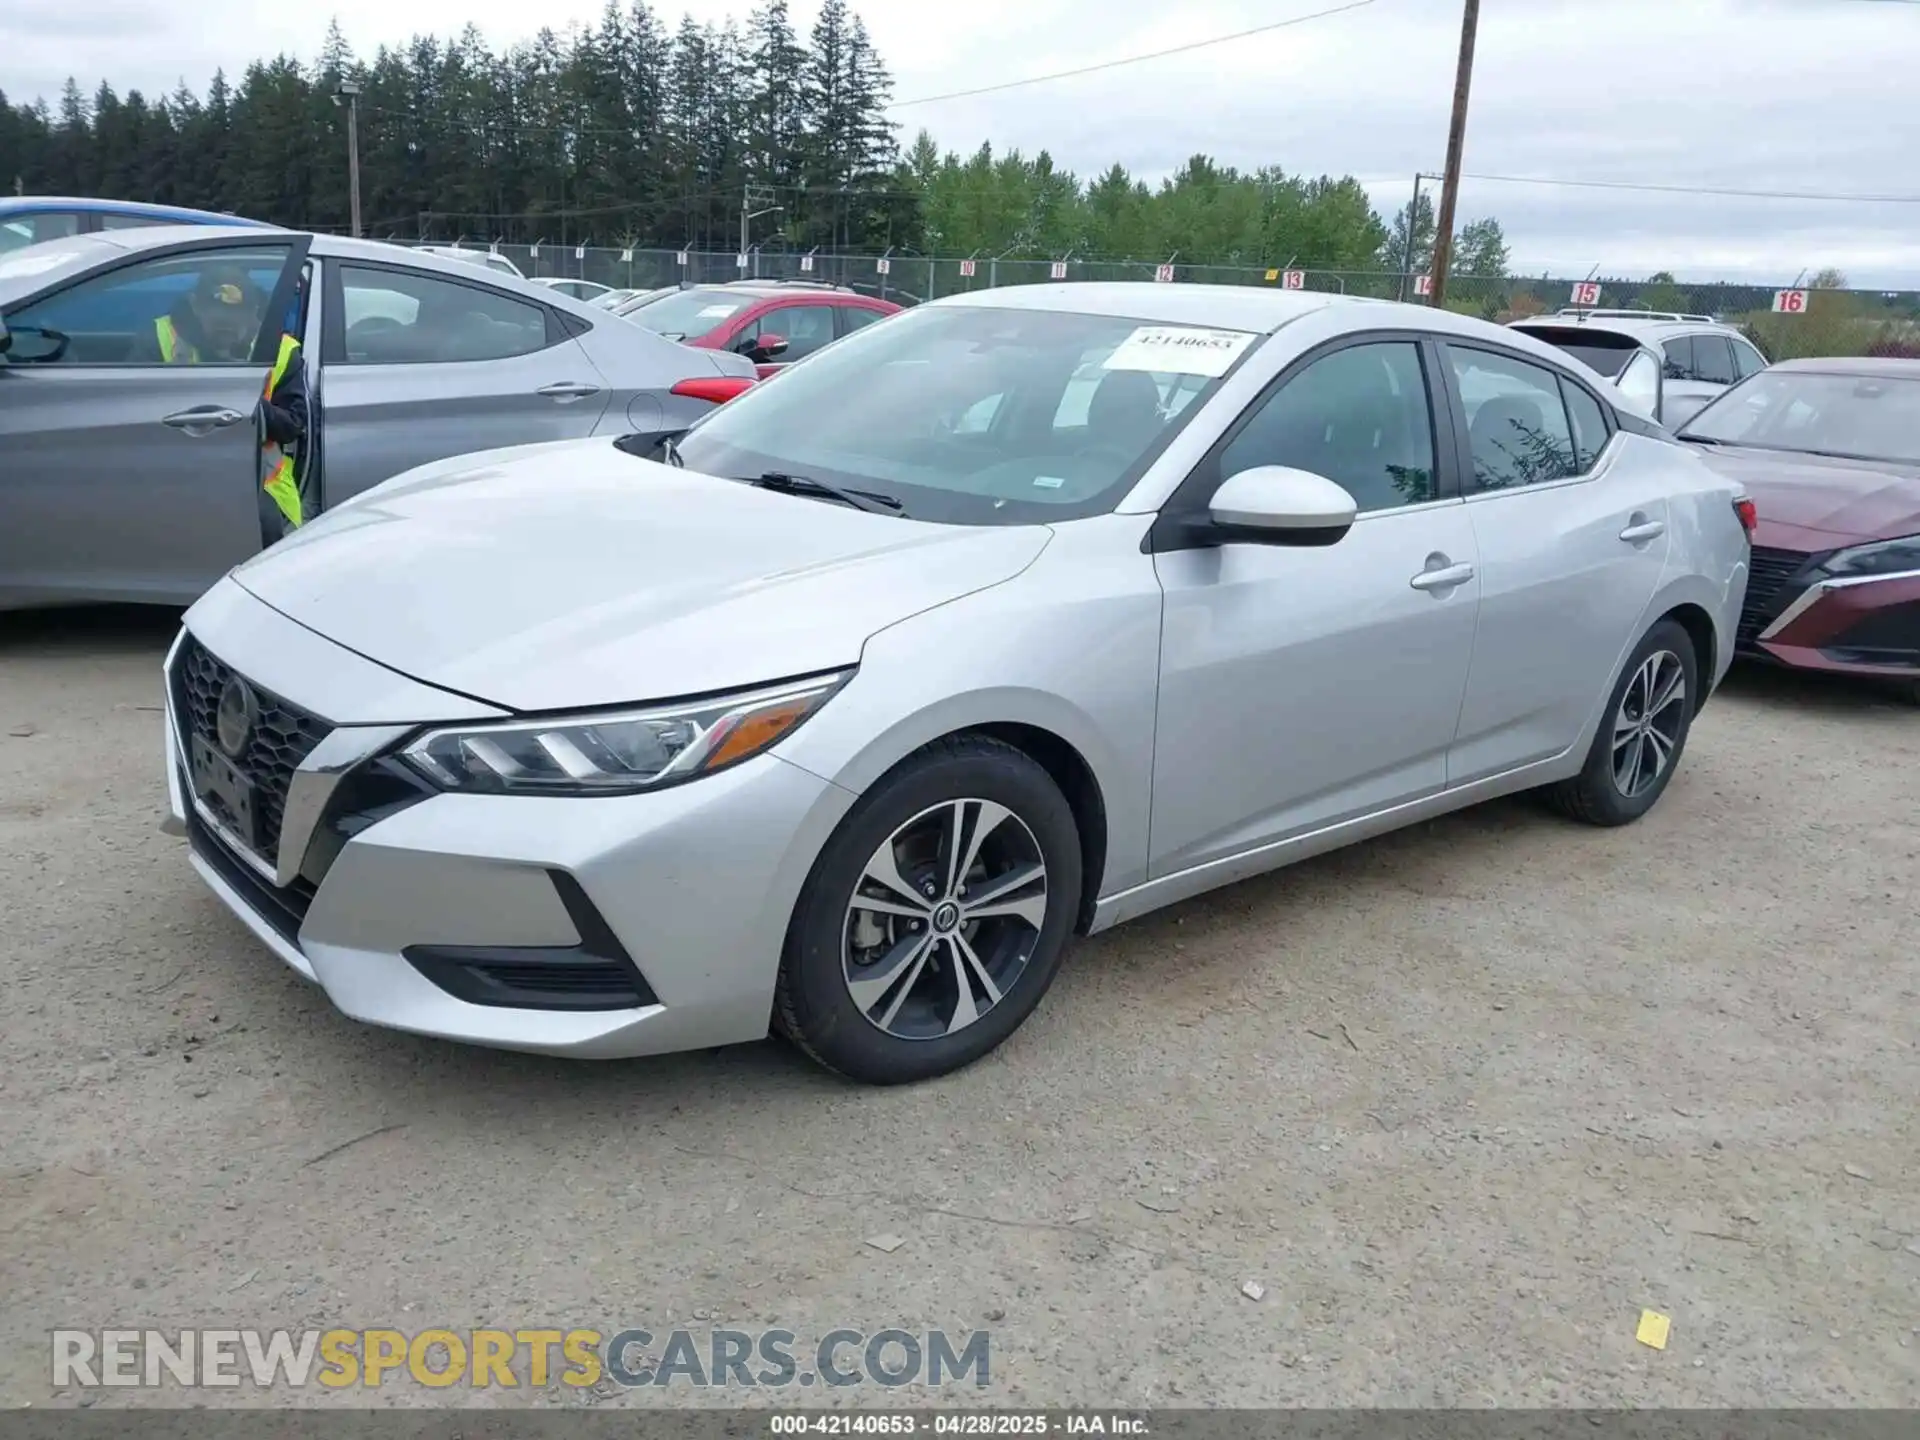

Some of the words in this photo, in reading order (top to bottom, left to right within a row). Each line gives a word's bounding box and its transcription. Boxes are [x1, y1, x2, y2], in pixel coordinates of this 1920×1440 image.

[963, 261, 973, 275] 10
[1160, 265, 1171, 281] 12
[1286, 272, 1300, 288] 13
[1577, 284, 1596, 303] 15
[1780, 292, 1802, 312] 16
